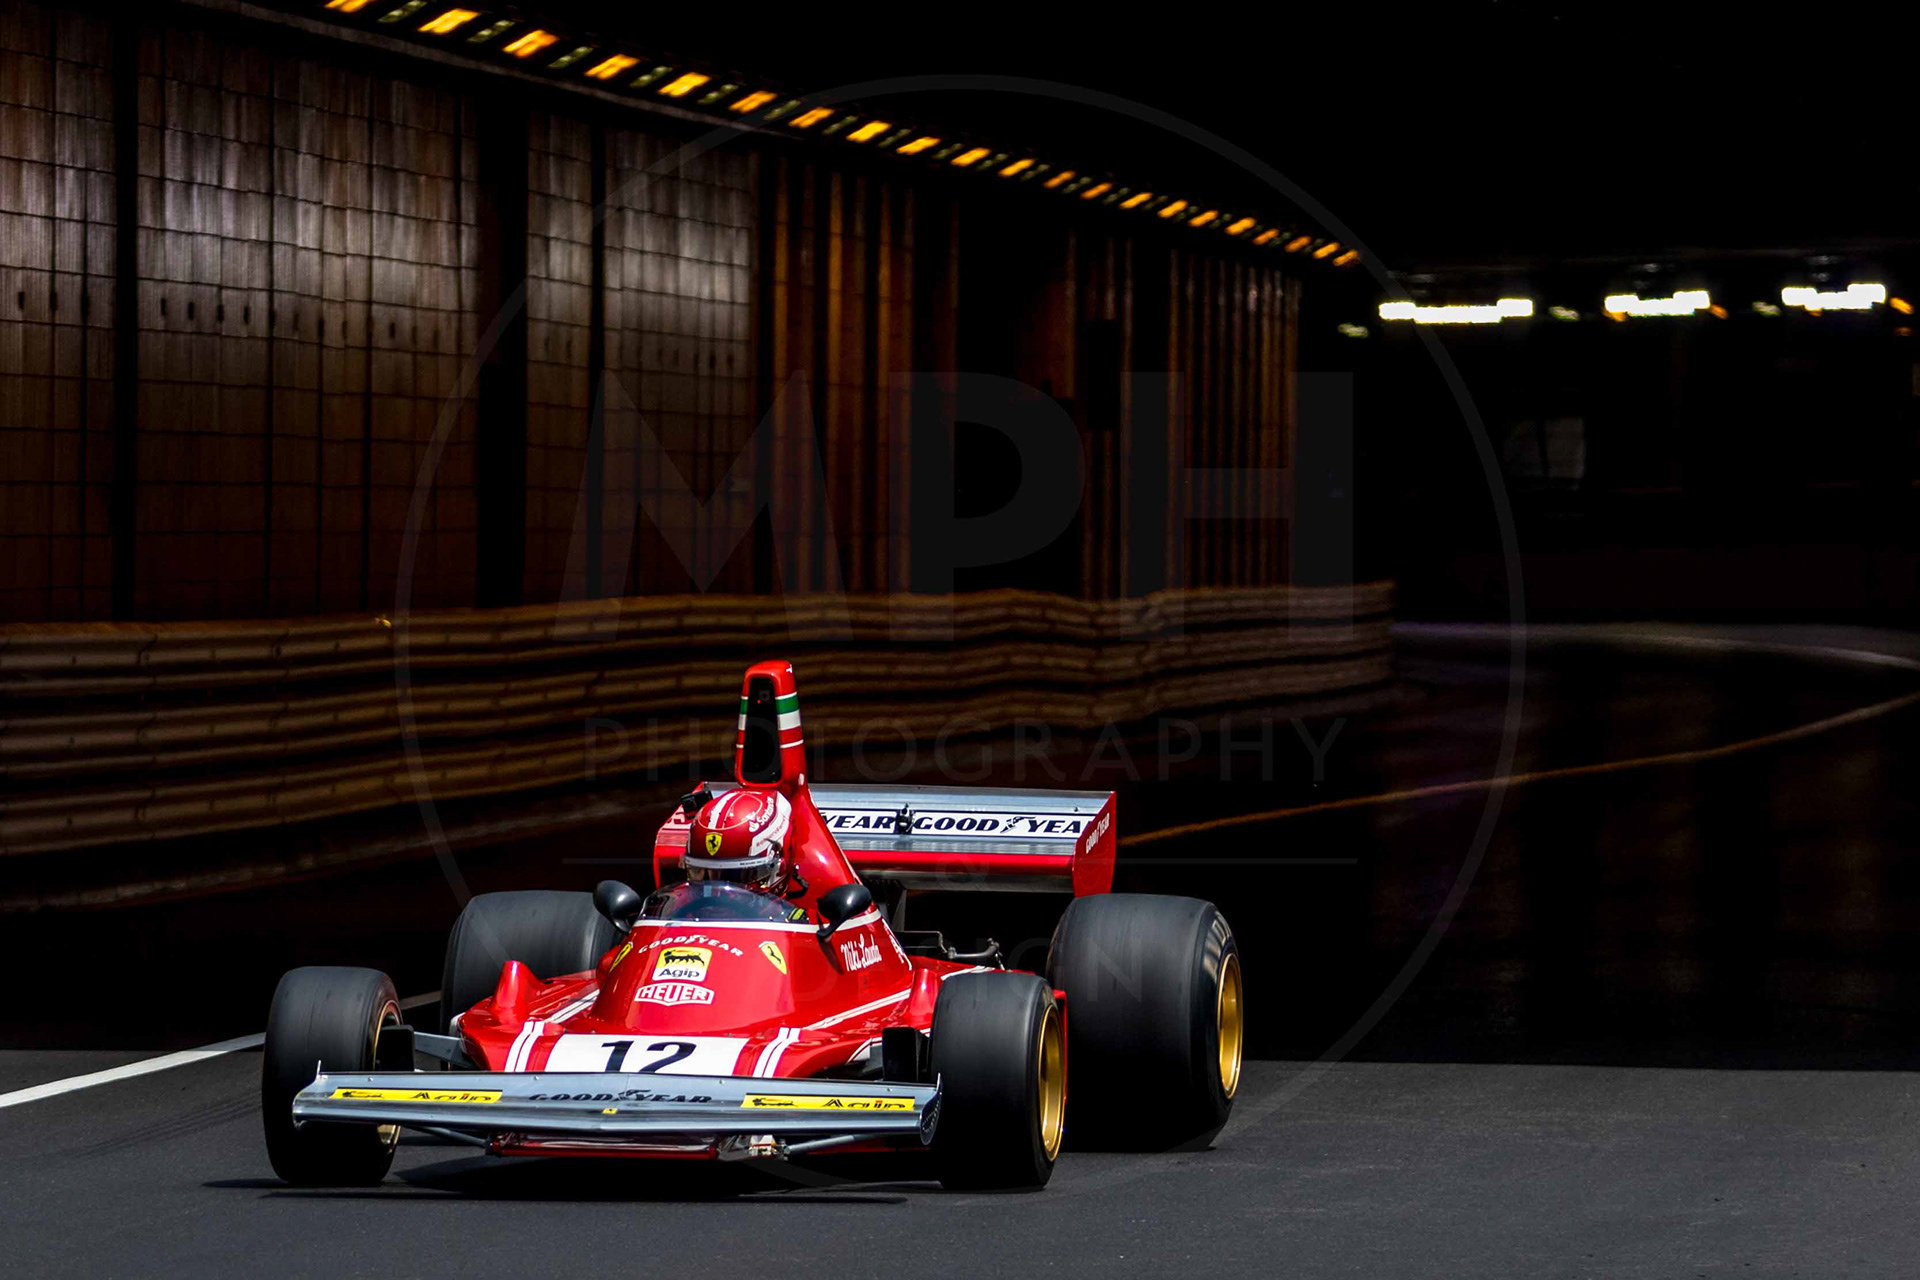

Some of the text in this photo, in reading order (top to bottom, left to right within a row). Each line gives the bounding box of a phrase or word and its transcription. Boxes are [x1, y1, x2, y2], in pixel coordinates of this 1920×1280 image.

[658, 968, 700, 978] Agip
[640, 984, 707, 1003] HEUER
[600, 1040, 697, 1075] 12
